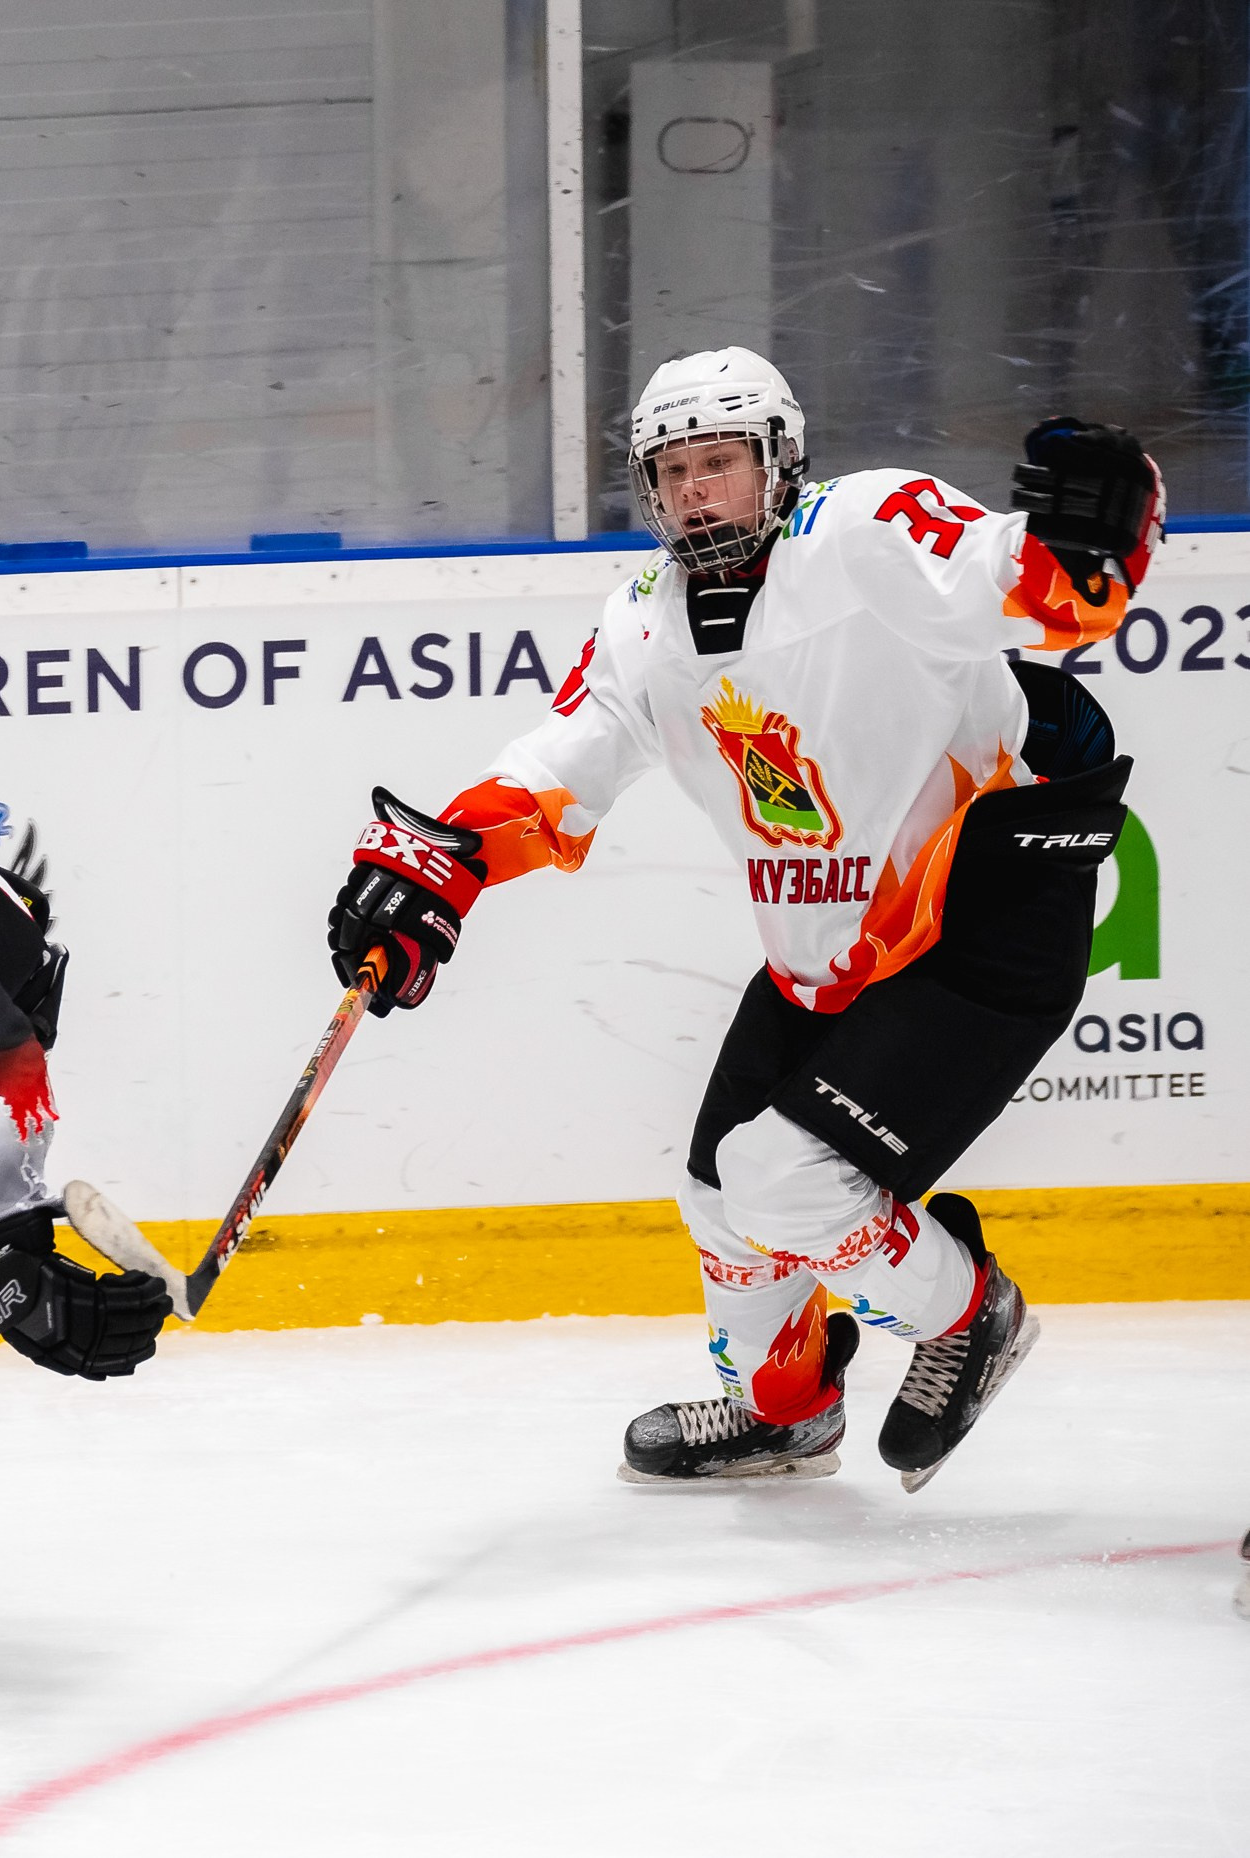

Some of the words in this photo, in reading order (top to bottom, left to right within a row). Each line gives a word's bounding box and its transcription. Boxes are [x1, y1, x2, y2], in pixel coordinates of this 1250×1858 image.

[183, 639, 308, 709] OF
[341, 629, 554, 702] ASIA
[1013, 833, 1113, 849] TRUE
[747, 856, 871, 904] КУЗБАСС
[384, 891, 406, 915] X92
[1073, 1012, 1205, 1053] asia
[815, 1077, 908, 1156] TRUE
